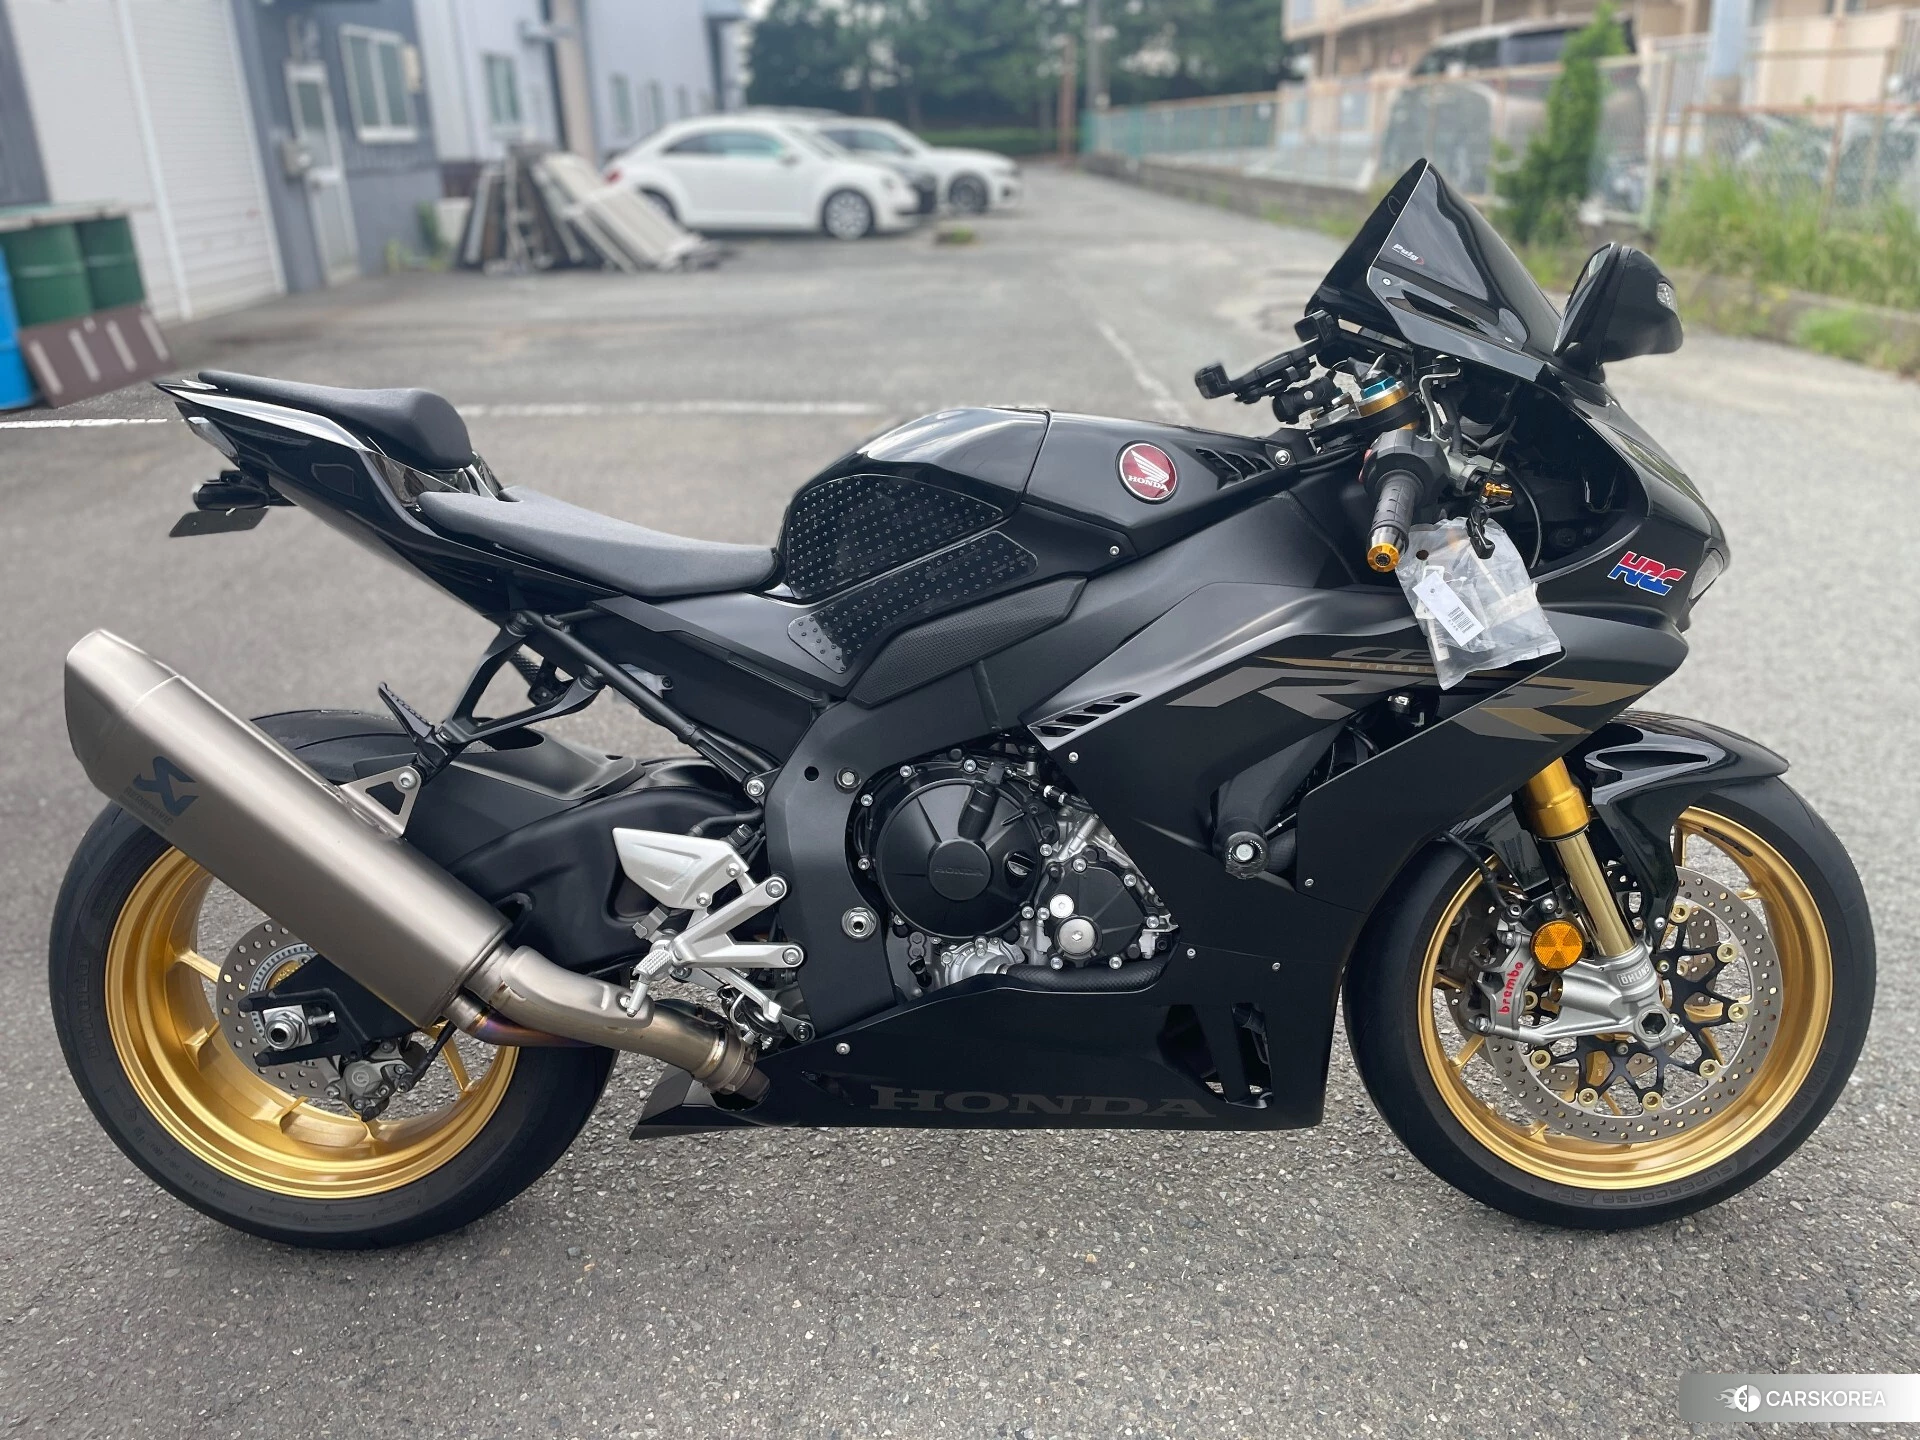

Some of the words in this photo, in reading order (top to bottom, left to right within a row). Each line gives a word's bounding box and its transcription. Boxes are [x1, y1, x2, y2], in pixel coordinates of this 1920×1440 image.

[1392, 243, 1419, 262] Puig
[1127, 474, 1170, 492] HONDA
[1607, 551, 1687, 596] HRC
[1331, 646, 1434, 664] CB
[1497, 961, 1523, 1013] brembo
[1620, 962, 1650, 984] ÖHLINS
[870, 1084, 1217, 1118] HONDA
[1602, 1163, 1733, 1204] SUPERCORSA
